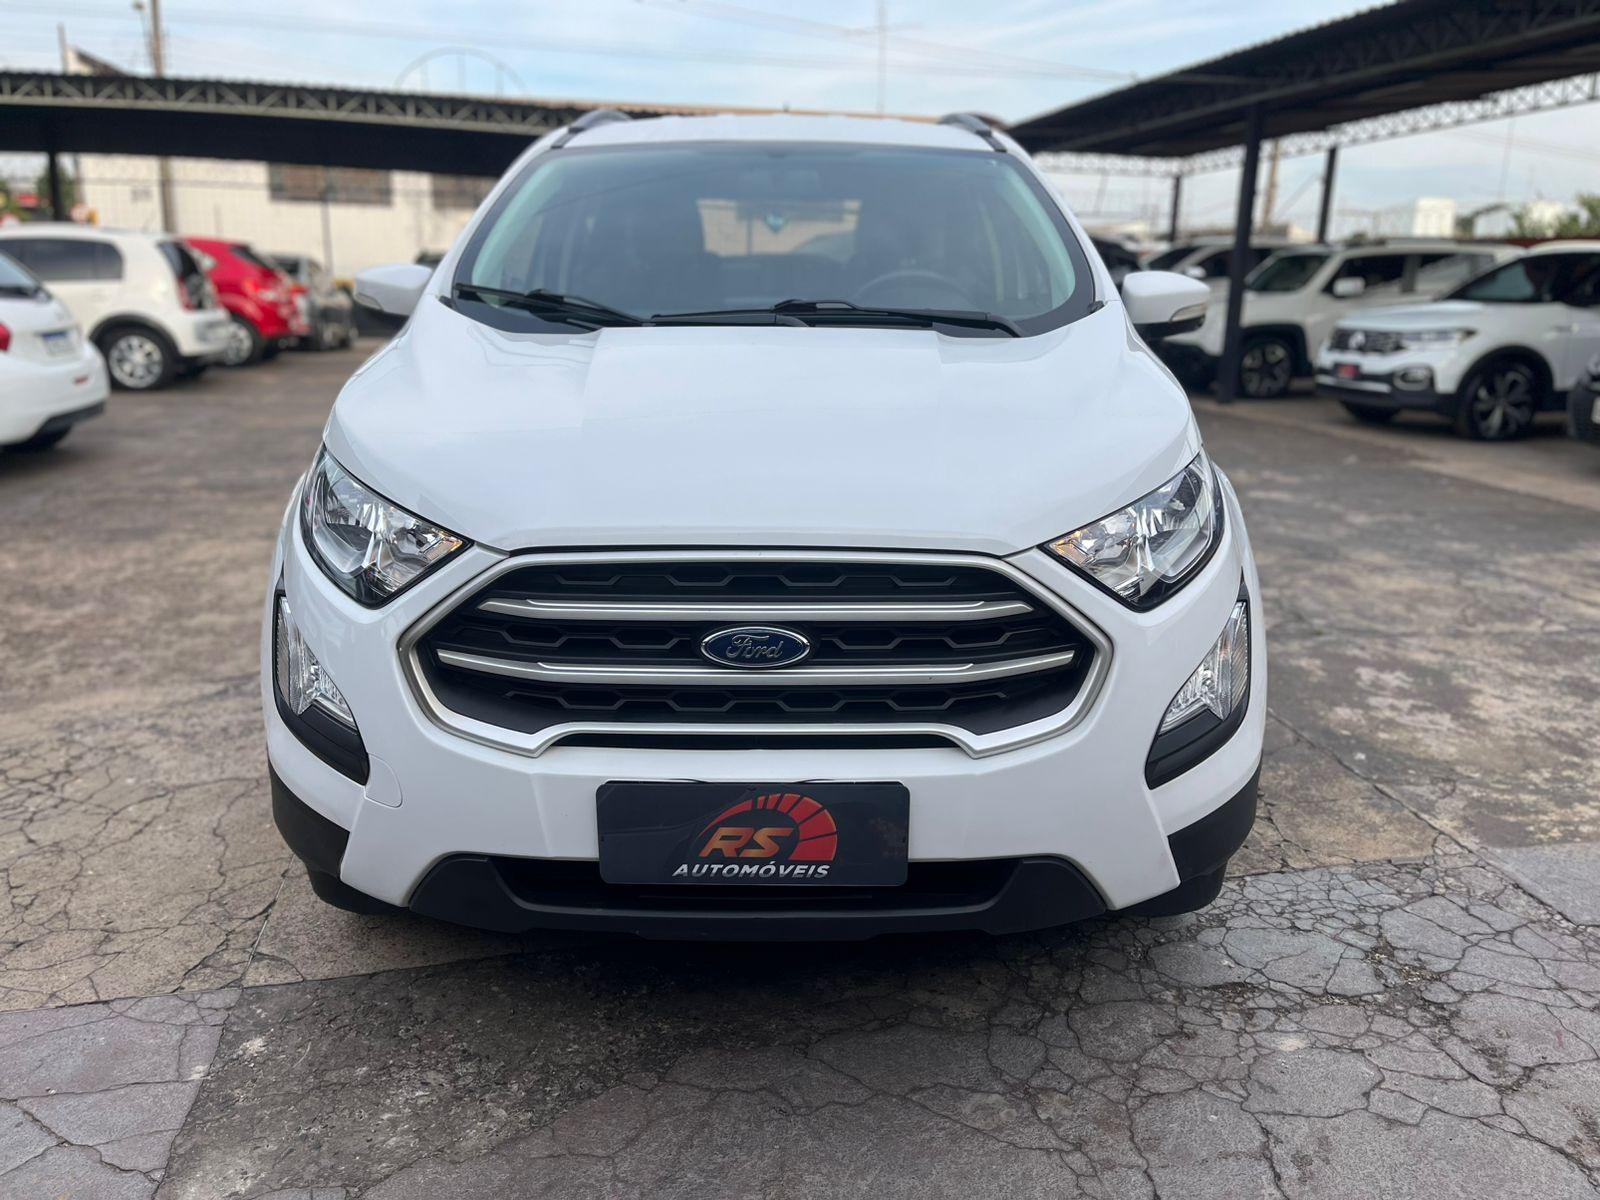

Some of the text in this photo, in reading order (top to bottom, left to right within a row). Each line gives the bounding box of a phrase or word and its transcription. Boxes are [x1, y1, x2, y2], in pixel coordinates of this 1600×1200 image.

[726, 634, 784, 658] Ford
[699, 827, 793, 857] RS
[672, 861, 830, 878] AUTOMÓVEIS
